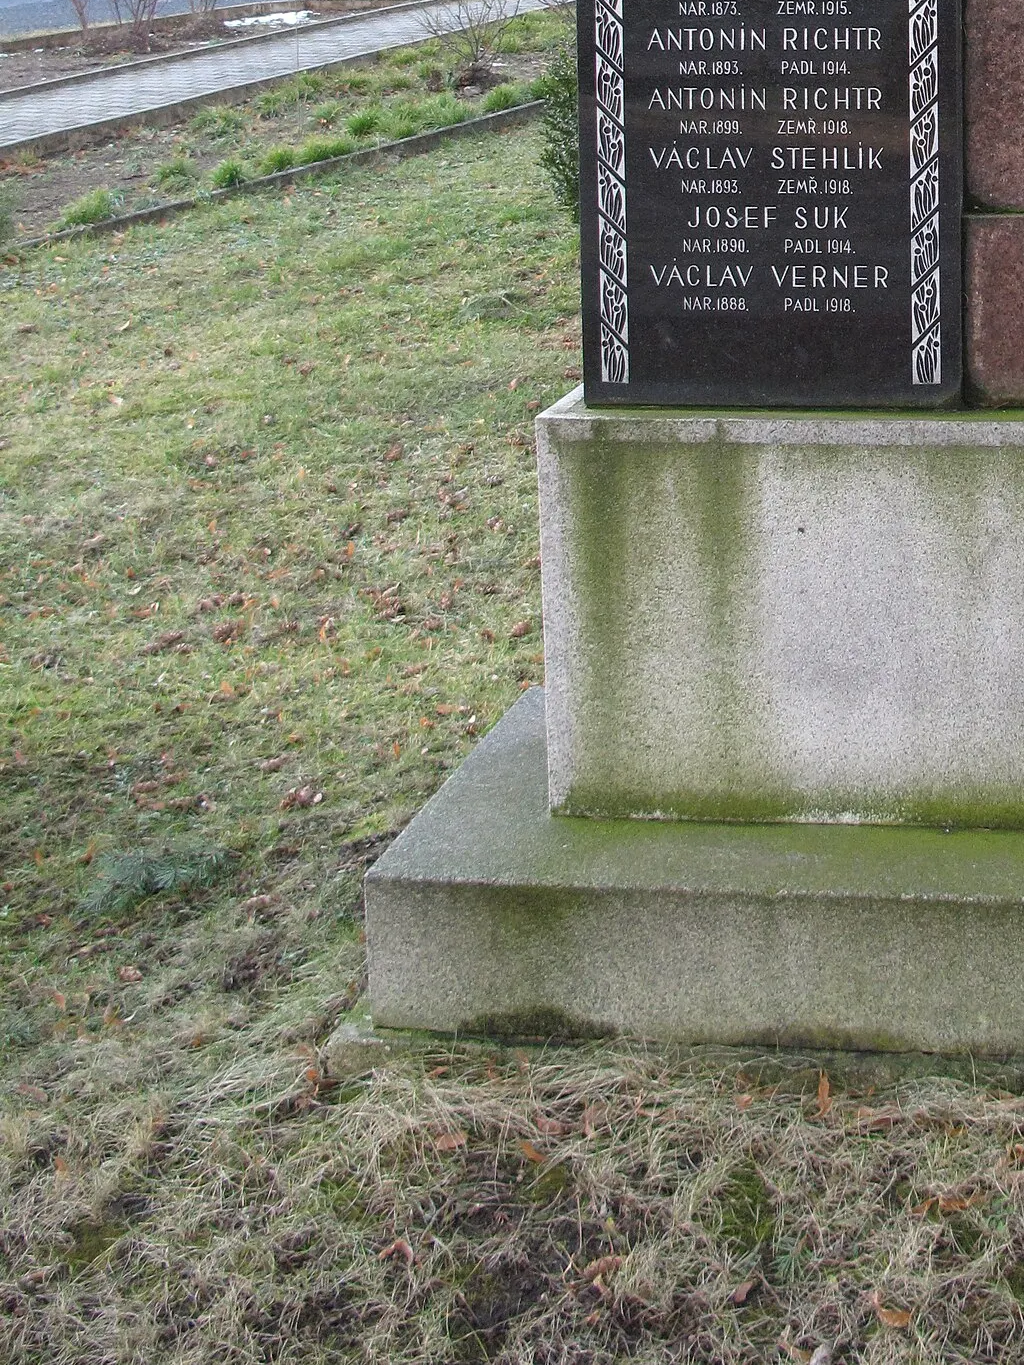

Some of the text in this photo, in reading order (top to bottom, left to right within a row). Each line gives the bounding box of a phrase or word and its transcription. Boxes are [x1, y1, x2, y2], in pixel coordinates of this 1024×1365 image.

[647, 21, 881, 51] ANTONÍN RICHTR
[781, 60, 818, 75] PADL
[822, 60, 851, 75] 1914.
[647, 83, 882, 111] ANTONÍN RICHTR
[648, 140, 884, 170] VÁCLAV STEHLÍK
[687, 206, 849, 229] JOSEF SUK
[784, 238, 823, 254] PADL
[827, 239, 856, 254] 1914.
[649, 257, 889, 289] VÁCLAV VERNER
[784, 297, 820, 312] PADL
[826, 297, 856, 313] 1918.
